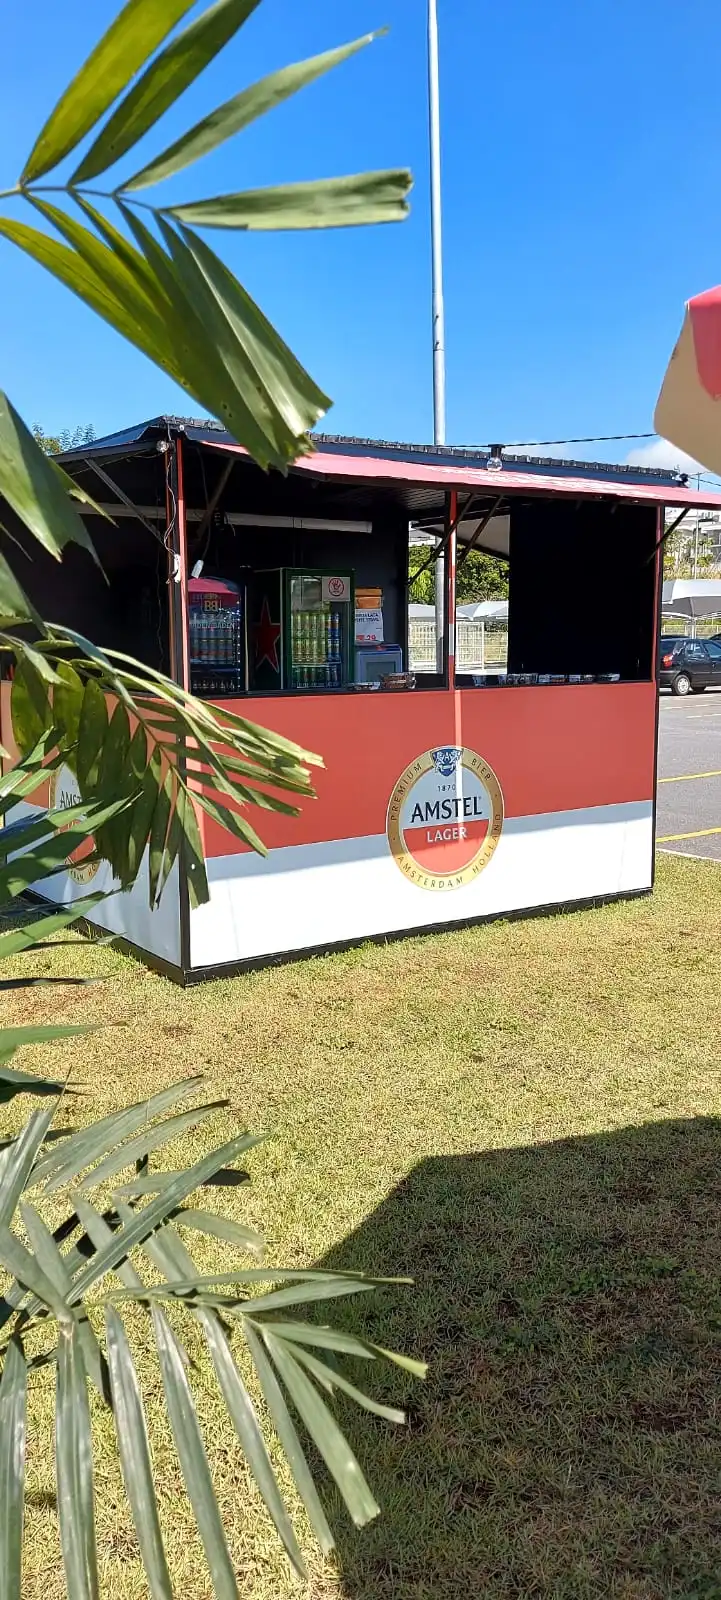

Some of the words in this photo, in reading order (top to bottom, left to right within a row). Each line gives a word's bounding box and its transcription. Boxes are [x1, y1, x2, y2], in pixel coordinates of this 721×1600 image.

[390, 762, 422, 821] PREMIUM
[471, 758, 491, 781] BIER
[437, 783, 456, 792] 1870
[410, 796, 482, 823] AMSTEL
[427, 827, 468, 843] LAGER
[397, 855, 463, 888] AMSTERDAM
[472, 814, 501, 874] HOLLAND
